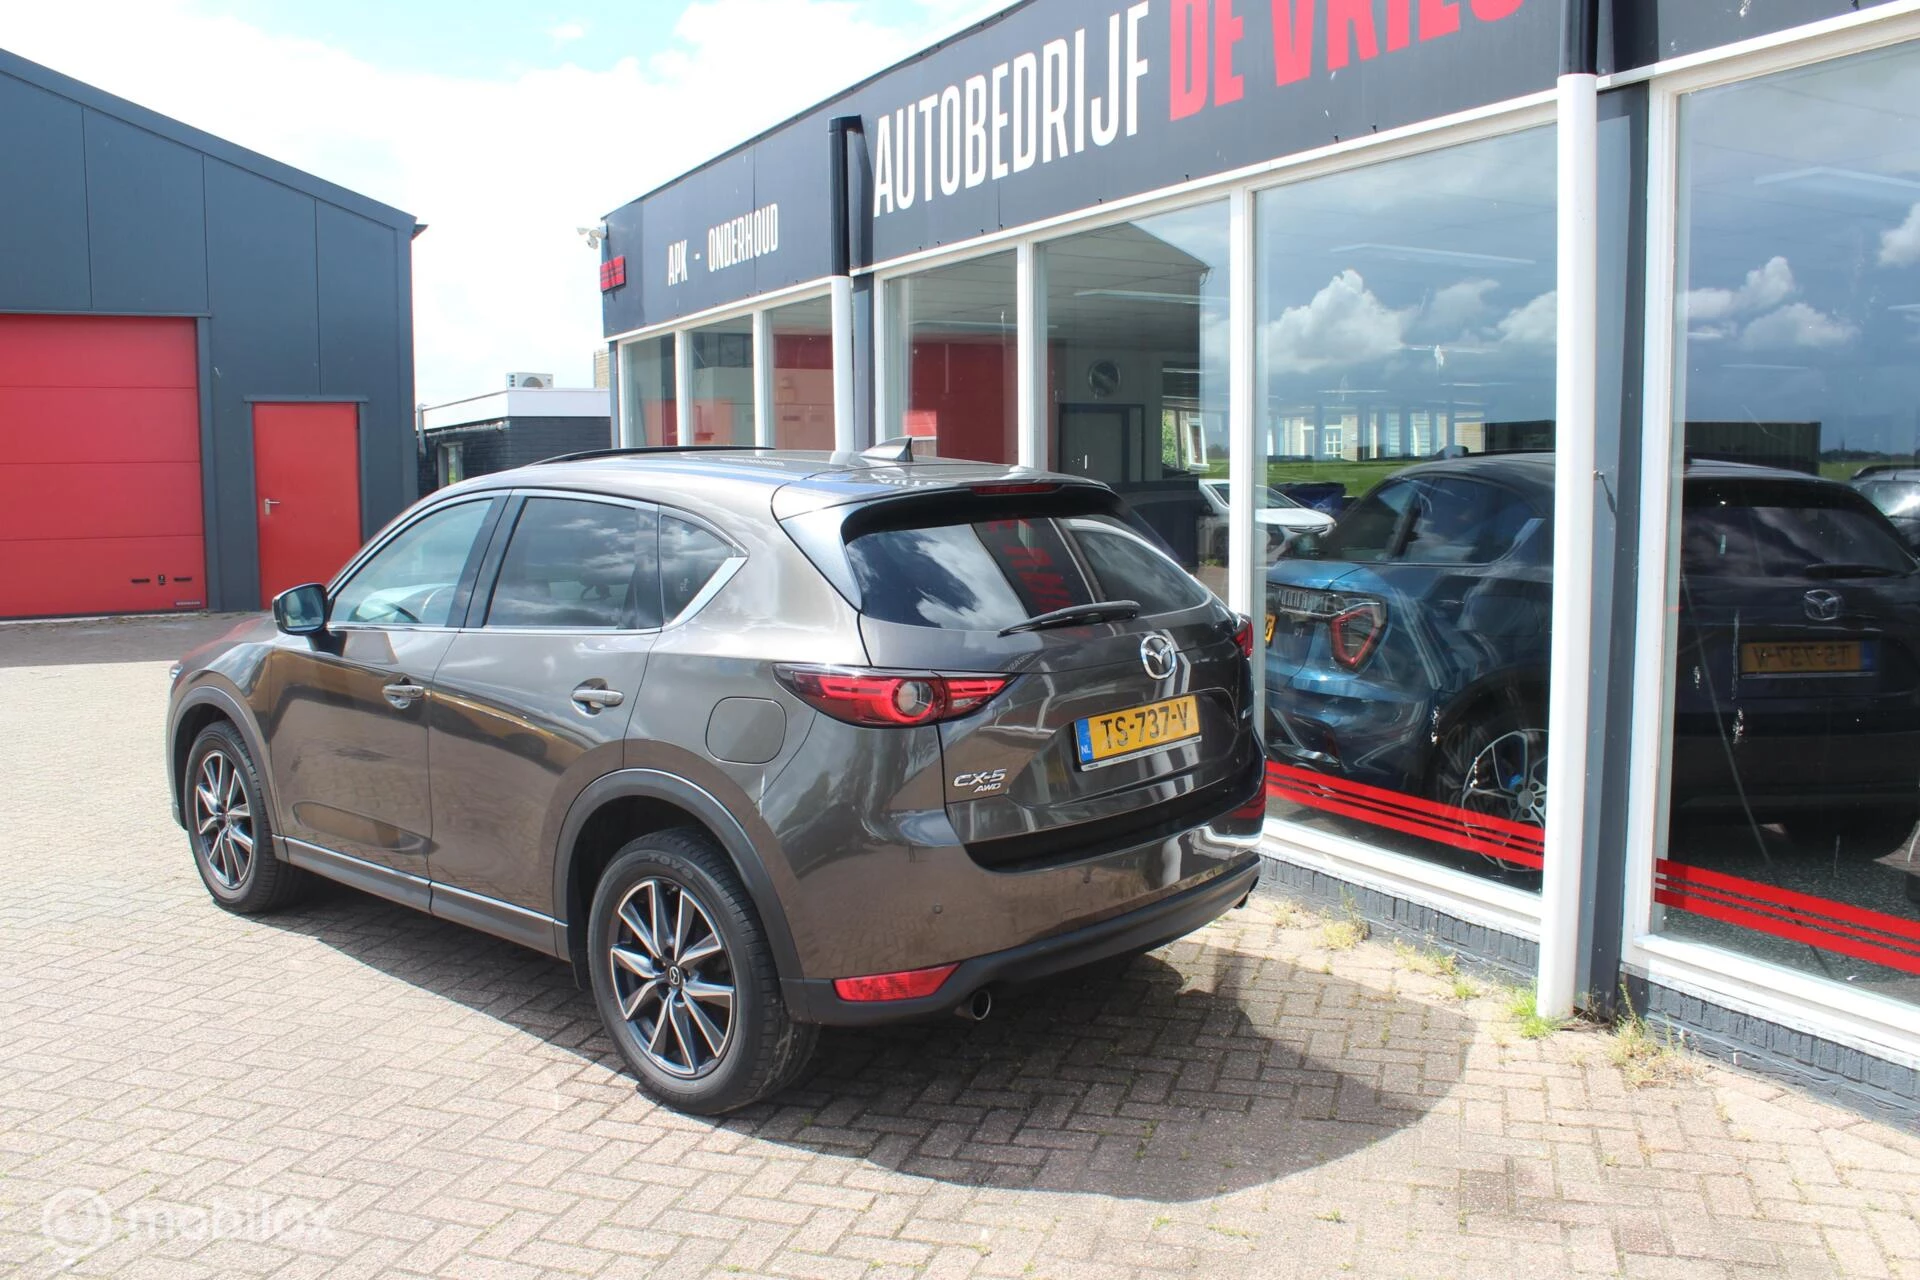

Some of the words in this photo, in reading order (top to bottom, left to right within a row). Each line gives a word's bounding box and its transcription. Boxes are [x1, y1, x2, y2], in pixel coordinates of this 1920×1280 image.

[873, 0, 1149, 218] AUTOBEDRIJF
[1169, 0, 1244, 122] DE
[667, 239, 689, 287] APK
[707, 203, 779, 273] ONDERHOUD
[1099, 701, 1189, 750] TS-737-V
[1080, 744, 1091, 755] NL
[953, 768, 1007, 787] CX-5
[973, 782, 1001, 793] AWD
